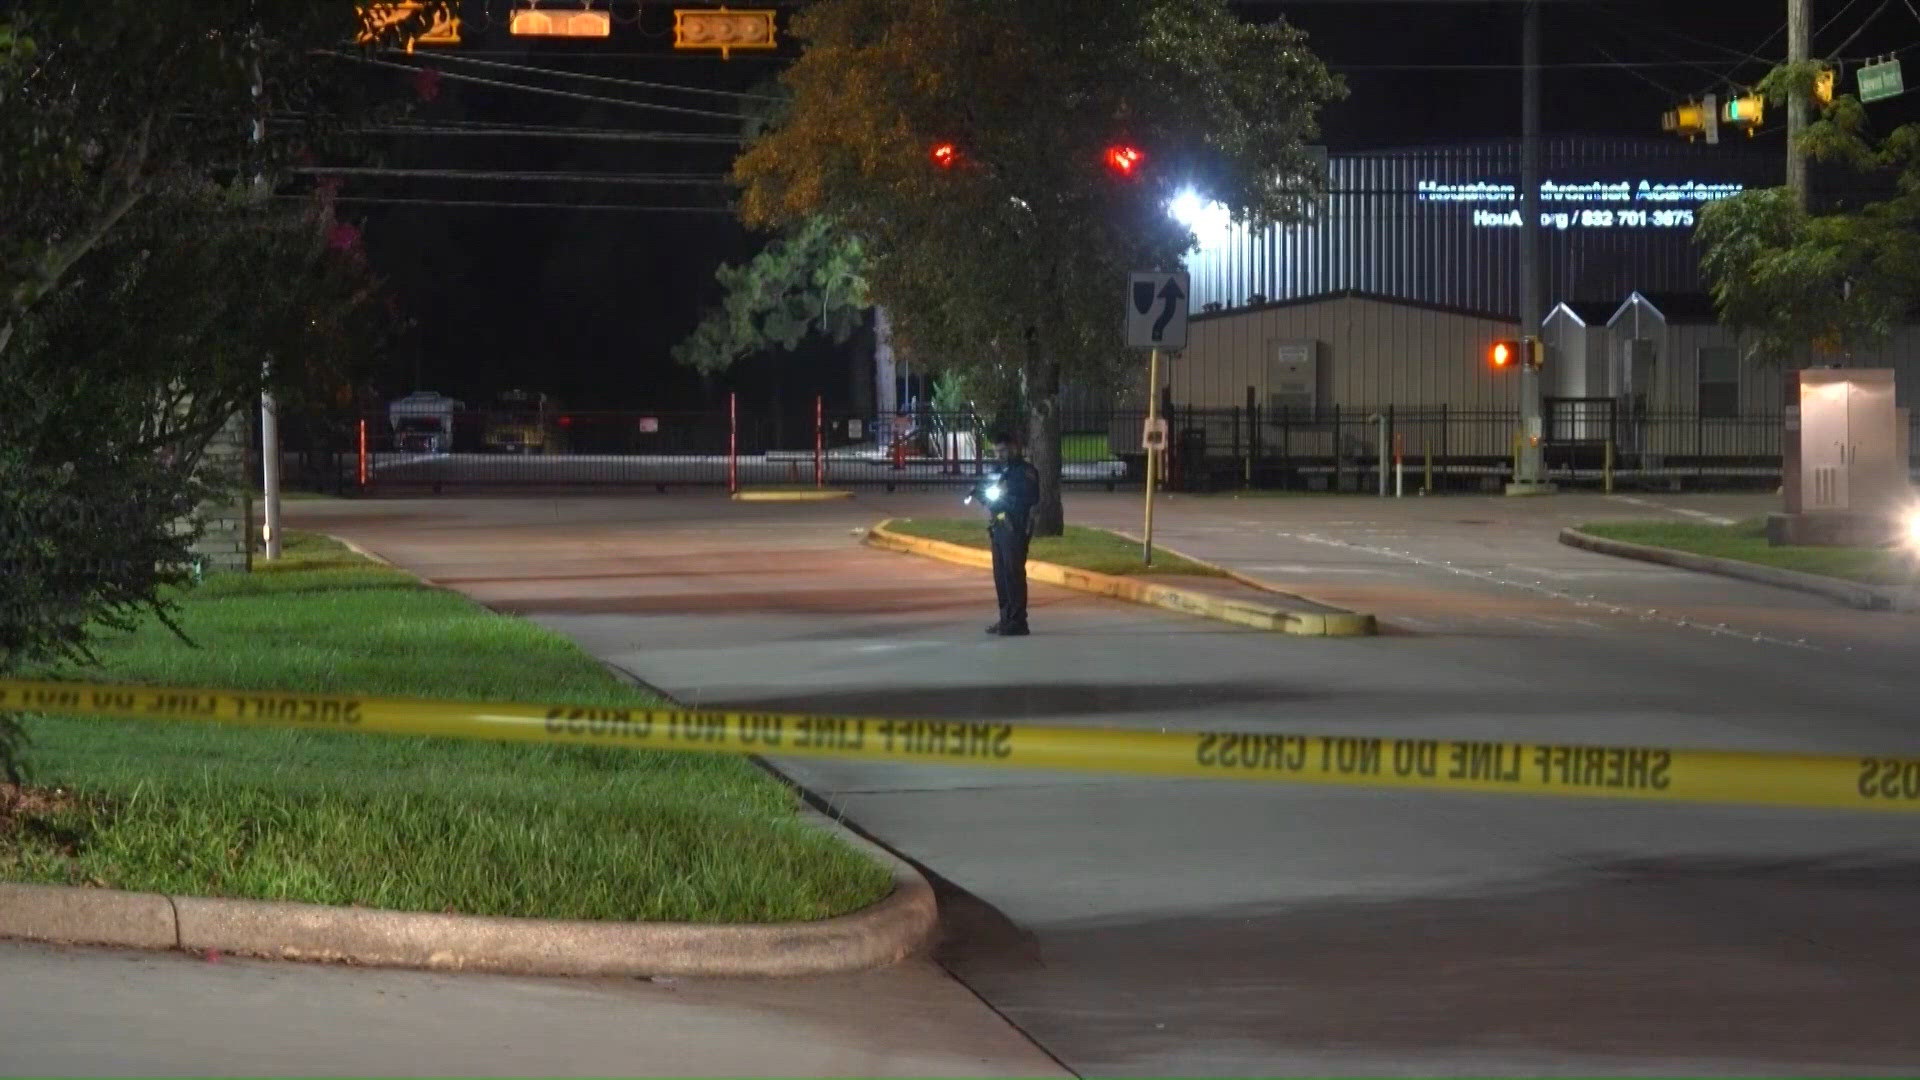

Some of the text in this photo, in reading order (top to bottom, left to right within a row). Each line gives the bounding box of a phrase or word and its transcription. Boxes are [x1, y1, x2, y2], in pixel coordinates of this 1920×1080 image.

[1418, 179, 1743, 201] Houston dventist Academy
